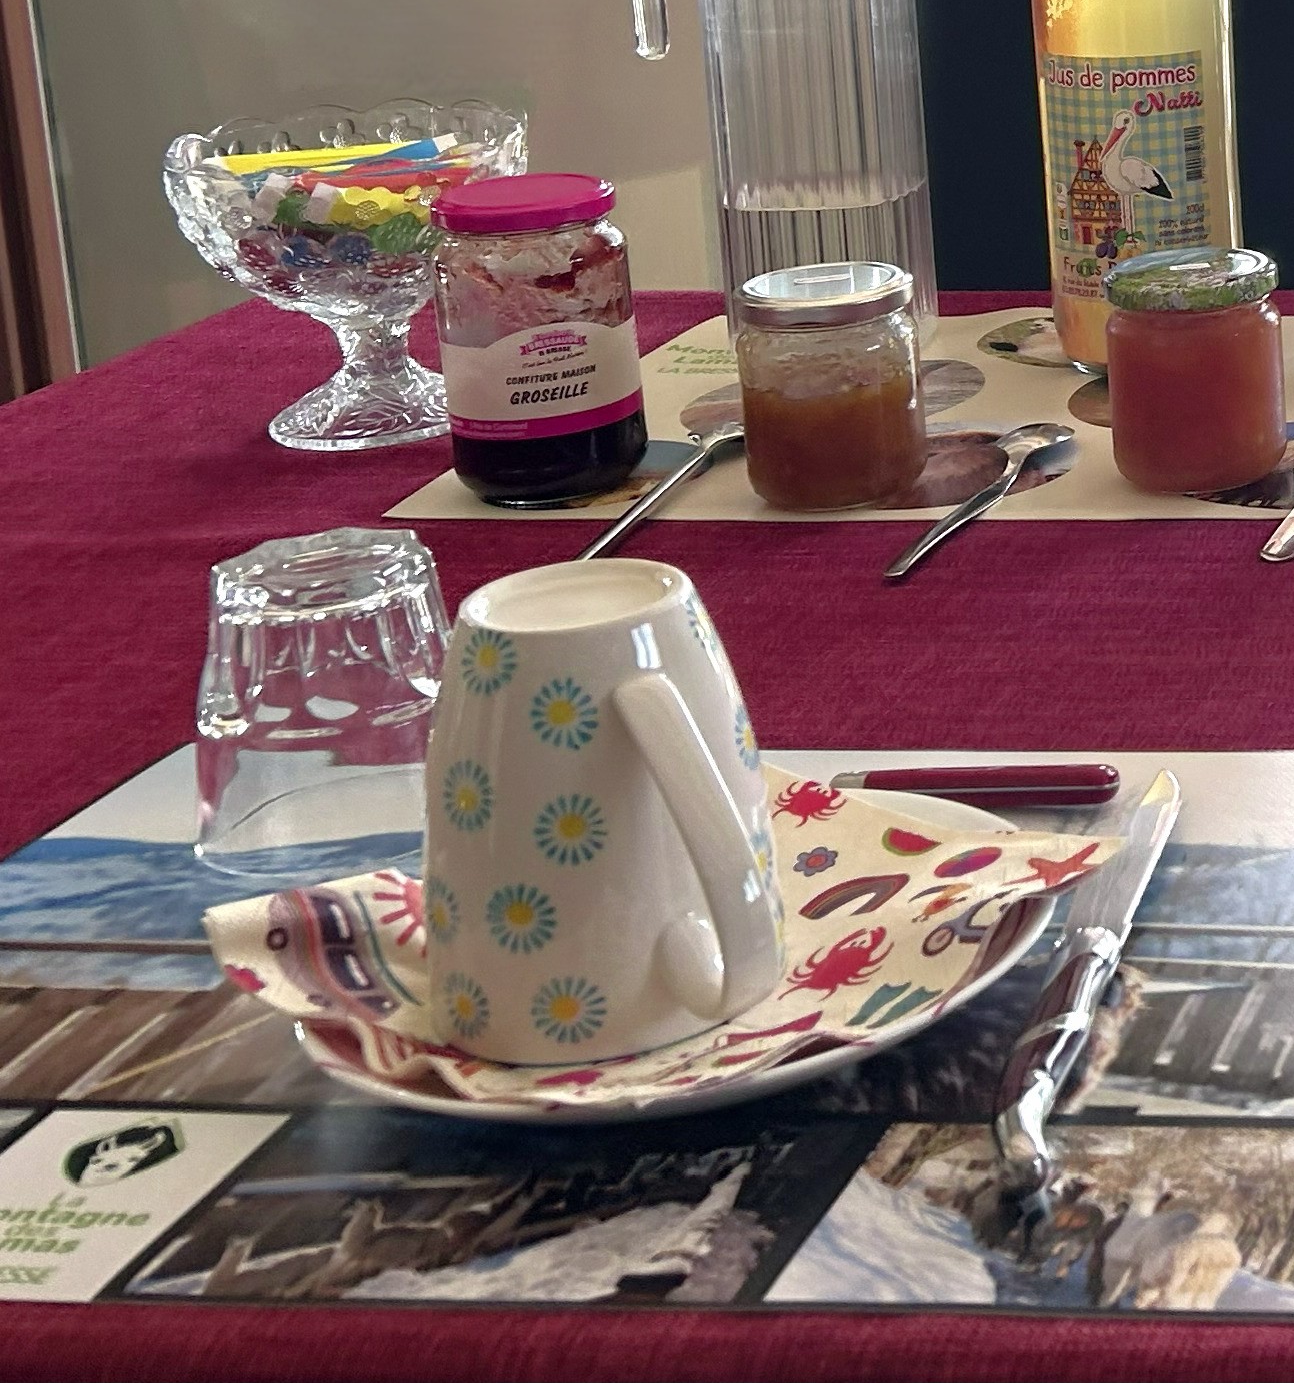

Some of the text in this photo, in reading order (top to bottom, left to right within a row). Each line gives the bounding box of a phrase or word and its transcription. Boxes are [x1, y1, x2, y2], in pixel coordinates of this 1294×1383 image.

[1049, 59, 1196, 94] Jus de pommes
[505, 364, 597, 386] CONFITURE MAISON
[510, 381, 589, 406] GROSEILLE
